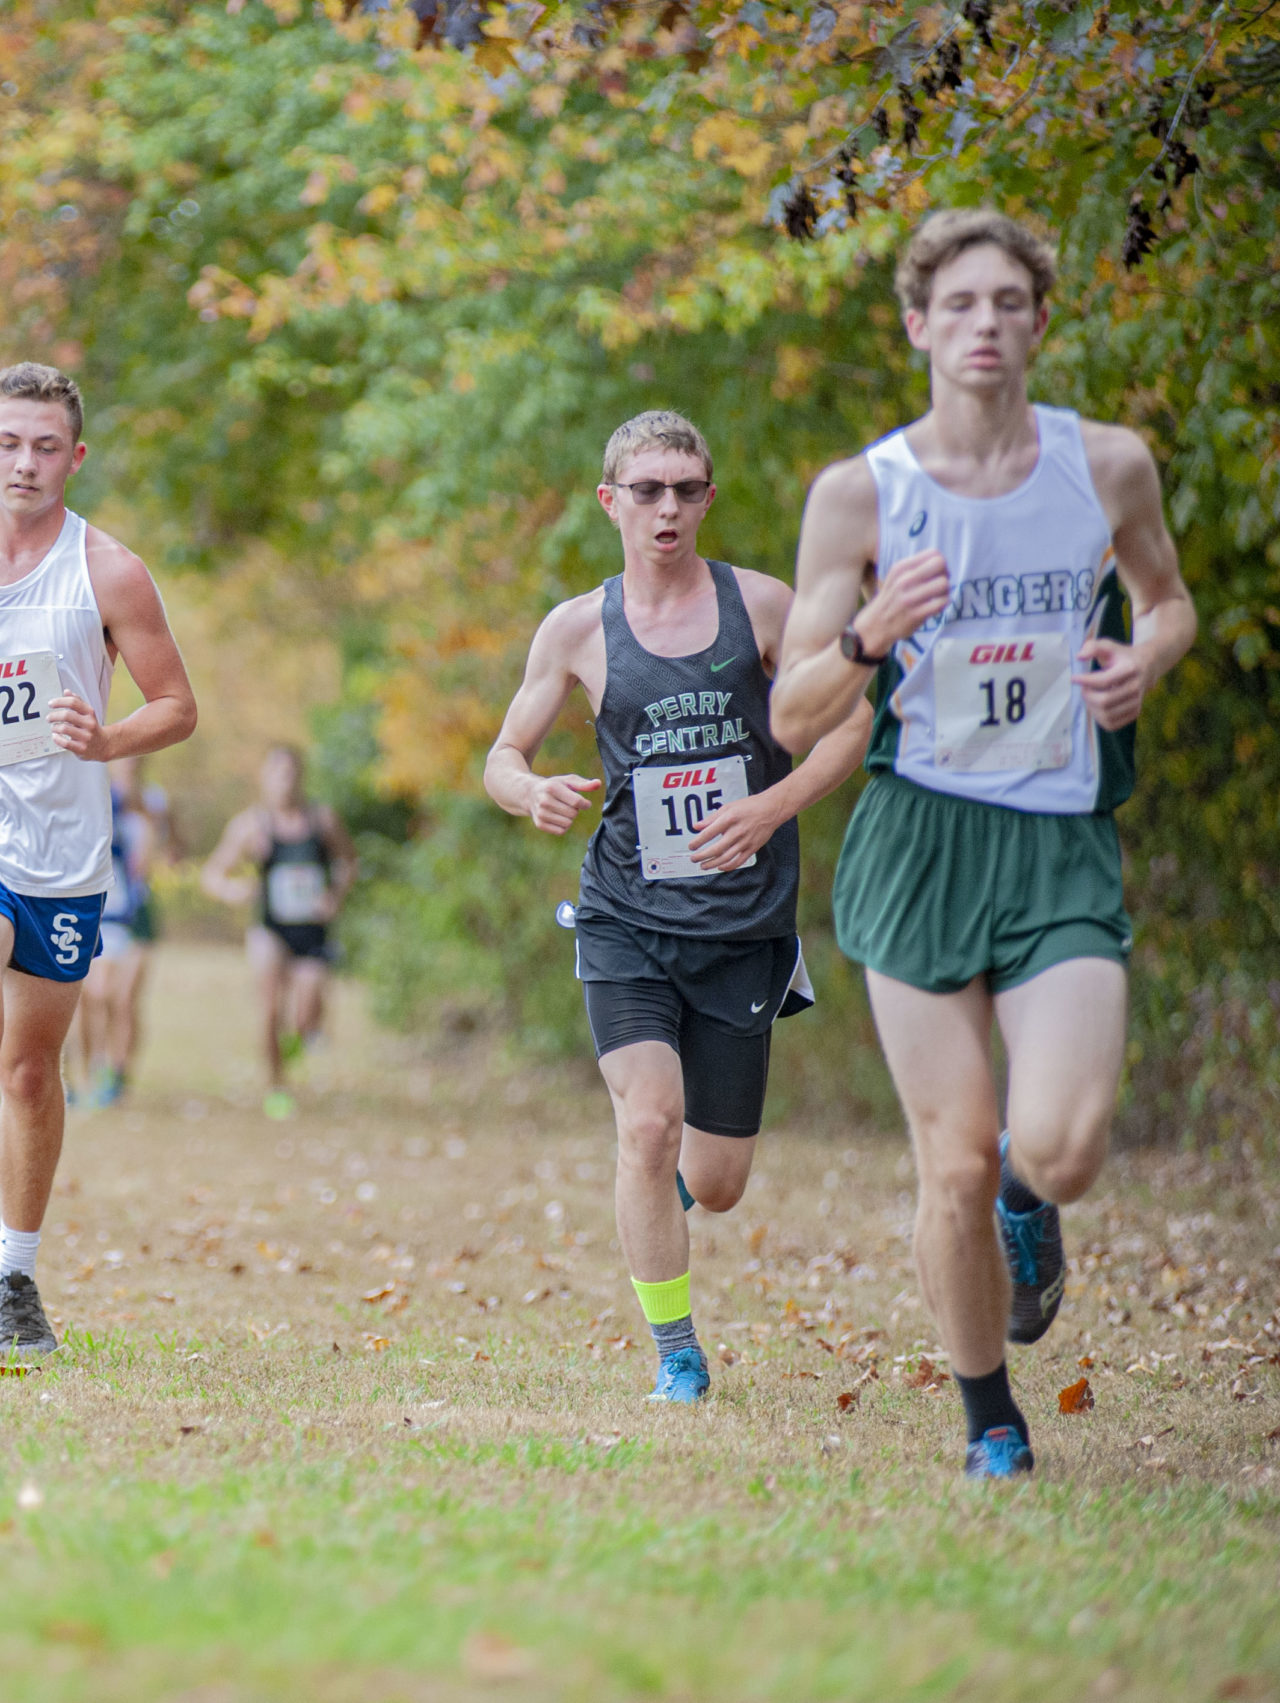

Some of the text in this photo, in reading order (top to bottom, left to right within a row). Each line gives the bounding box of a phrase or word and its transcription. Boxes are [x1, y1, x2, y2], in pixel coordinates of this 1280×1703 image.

[969, 642, 1035, 665] GILL
[644, 691, 733, 728] PERRY
[979, 677, 1027, 728] 18
[635, 717, 751, 757] CENTRAL
[662, 766, 718, 789] GILL
